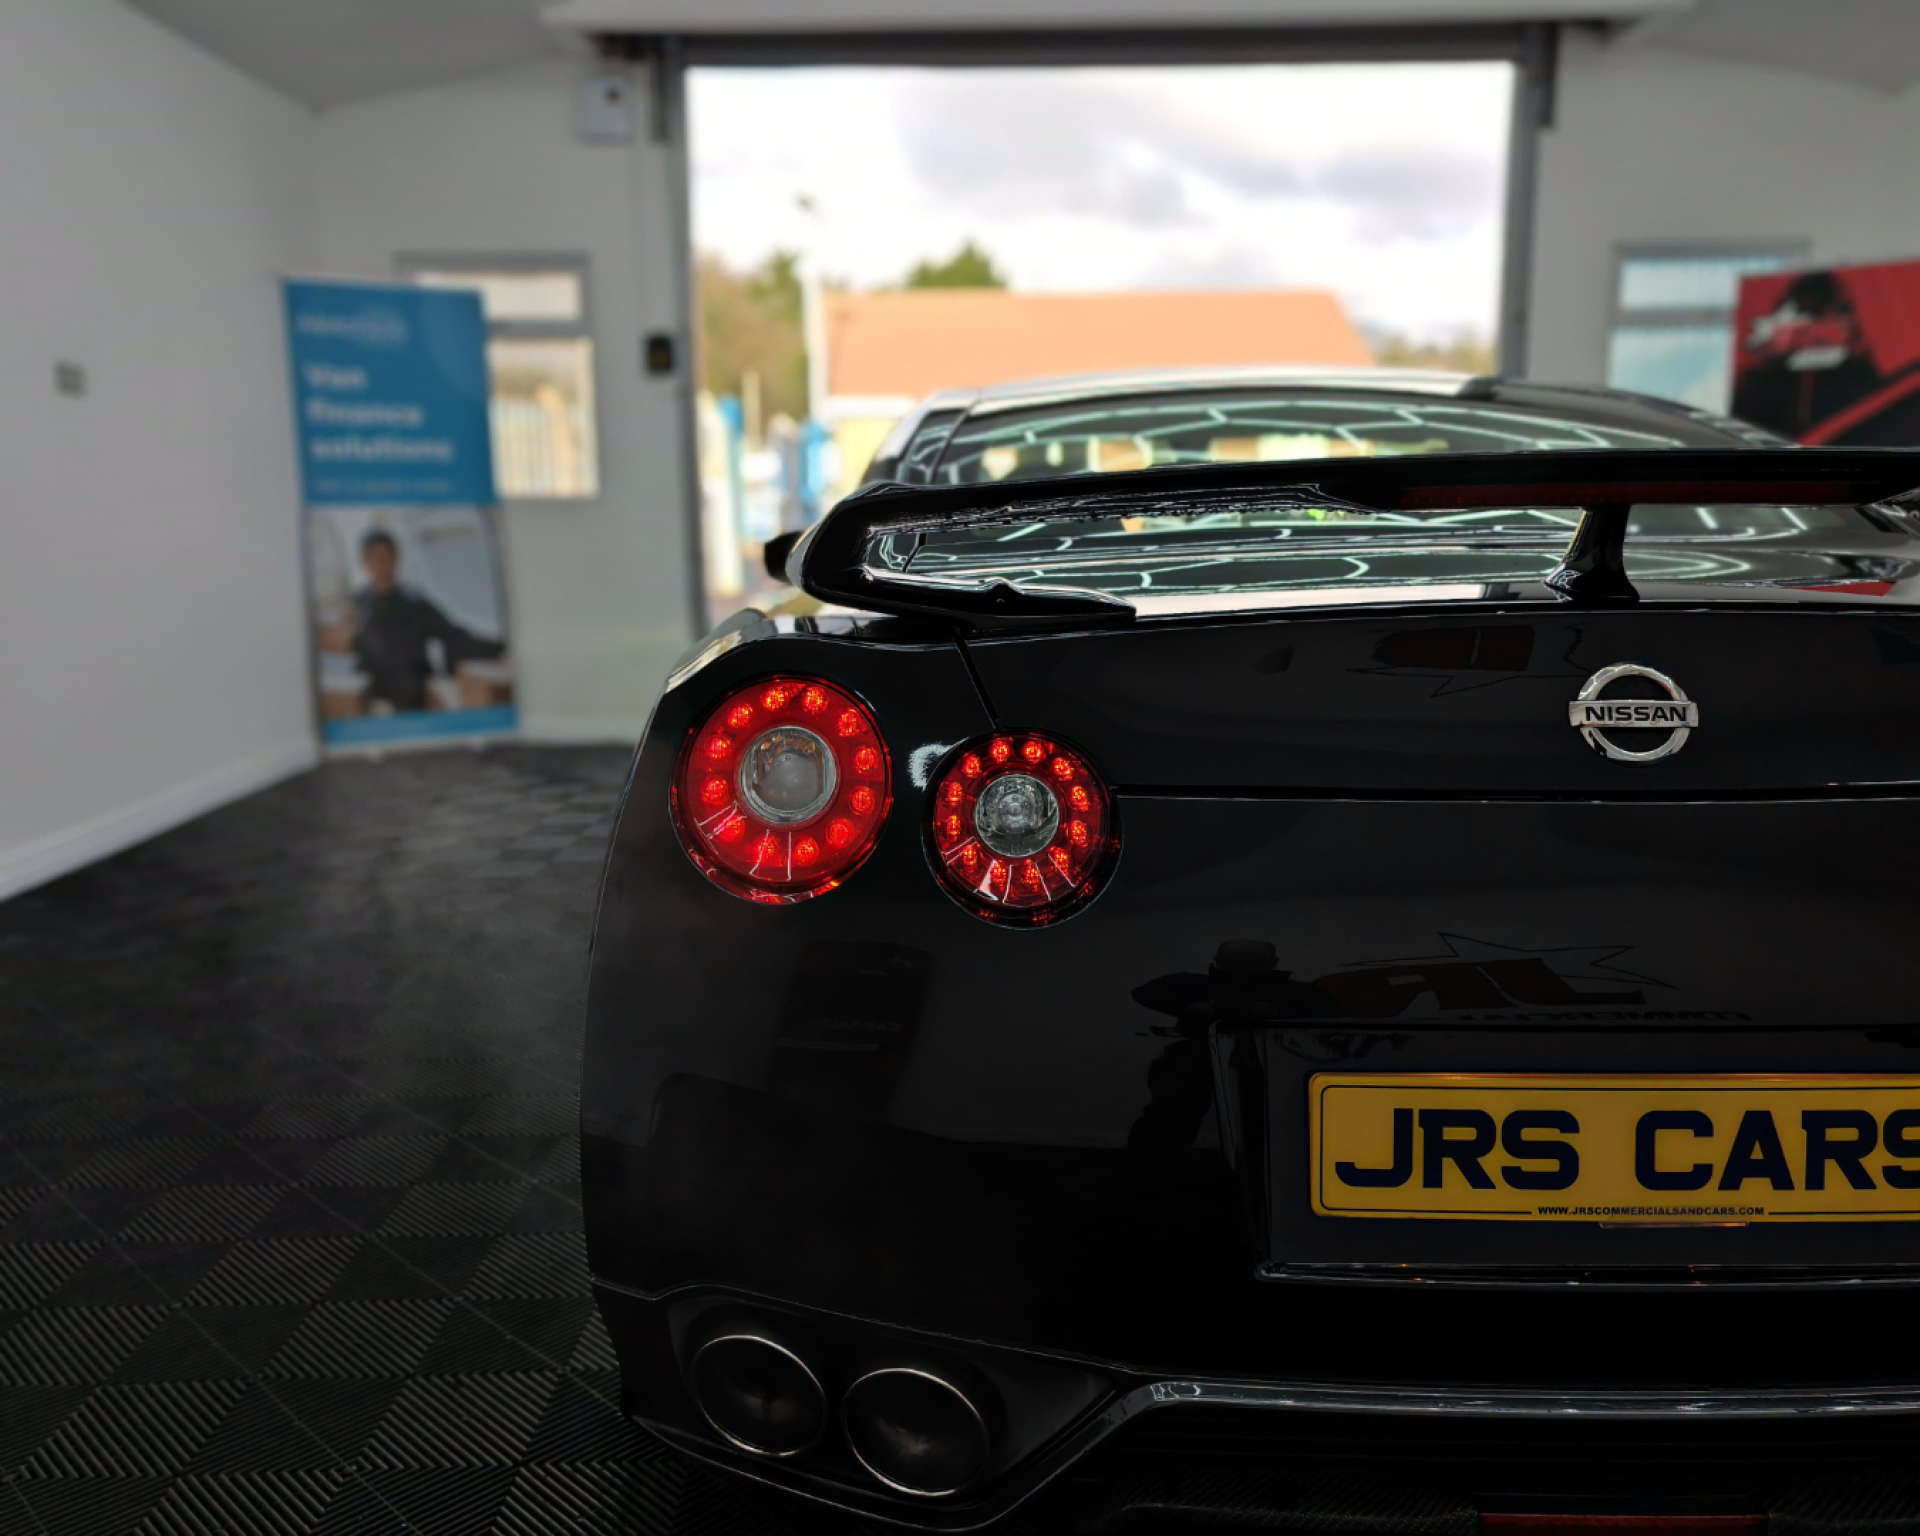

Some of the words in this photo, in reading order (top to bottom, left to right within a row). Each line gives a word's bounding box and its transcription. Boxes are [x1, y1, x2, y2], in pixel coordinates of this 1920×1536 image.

[1586, 706, 1687, 721] NISSAN
[1335, 1108, 1580, 1190] JRS
[1537, 1206, 1765, 1216] WWW.JRSCOMMERCIALSANDCARS.COM
